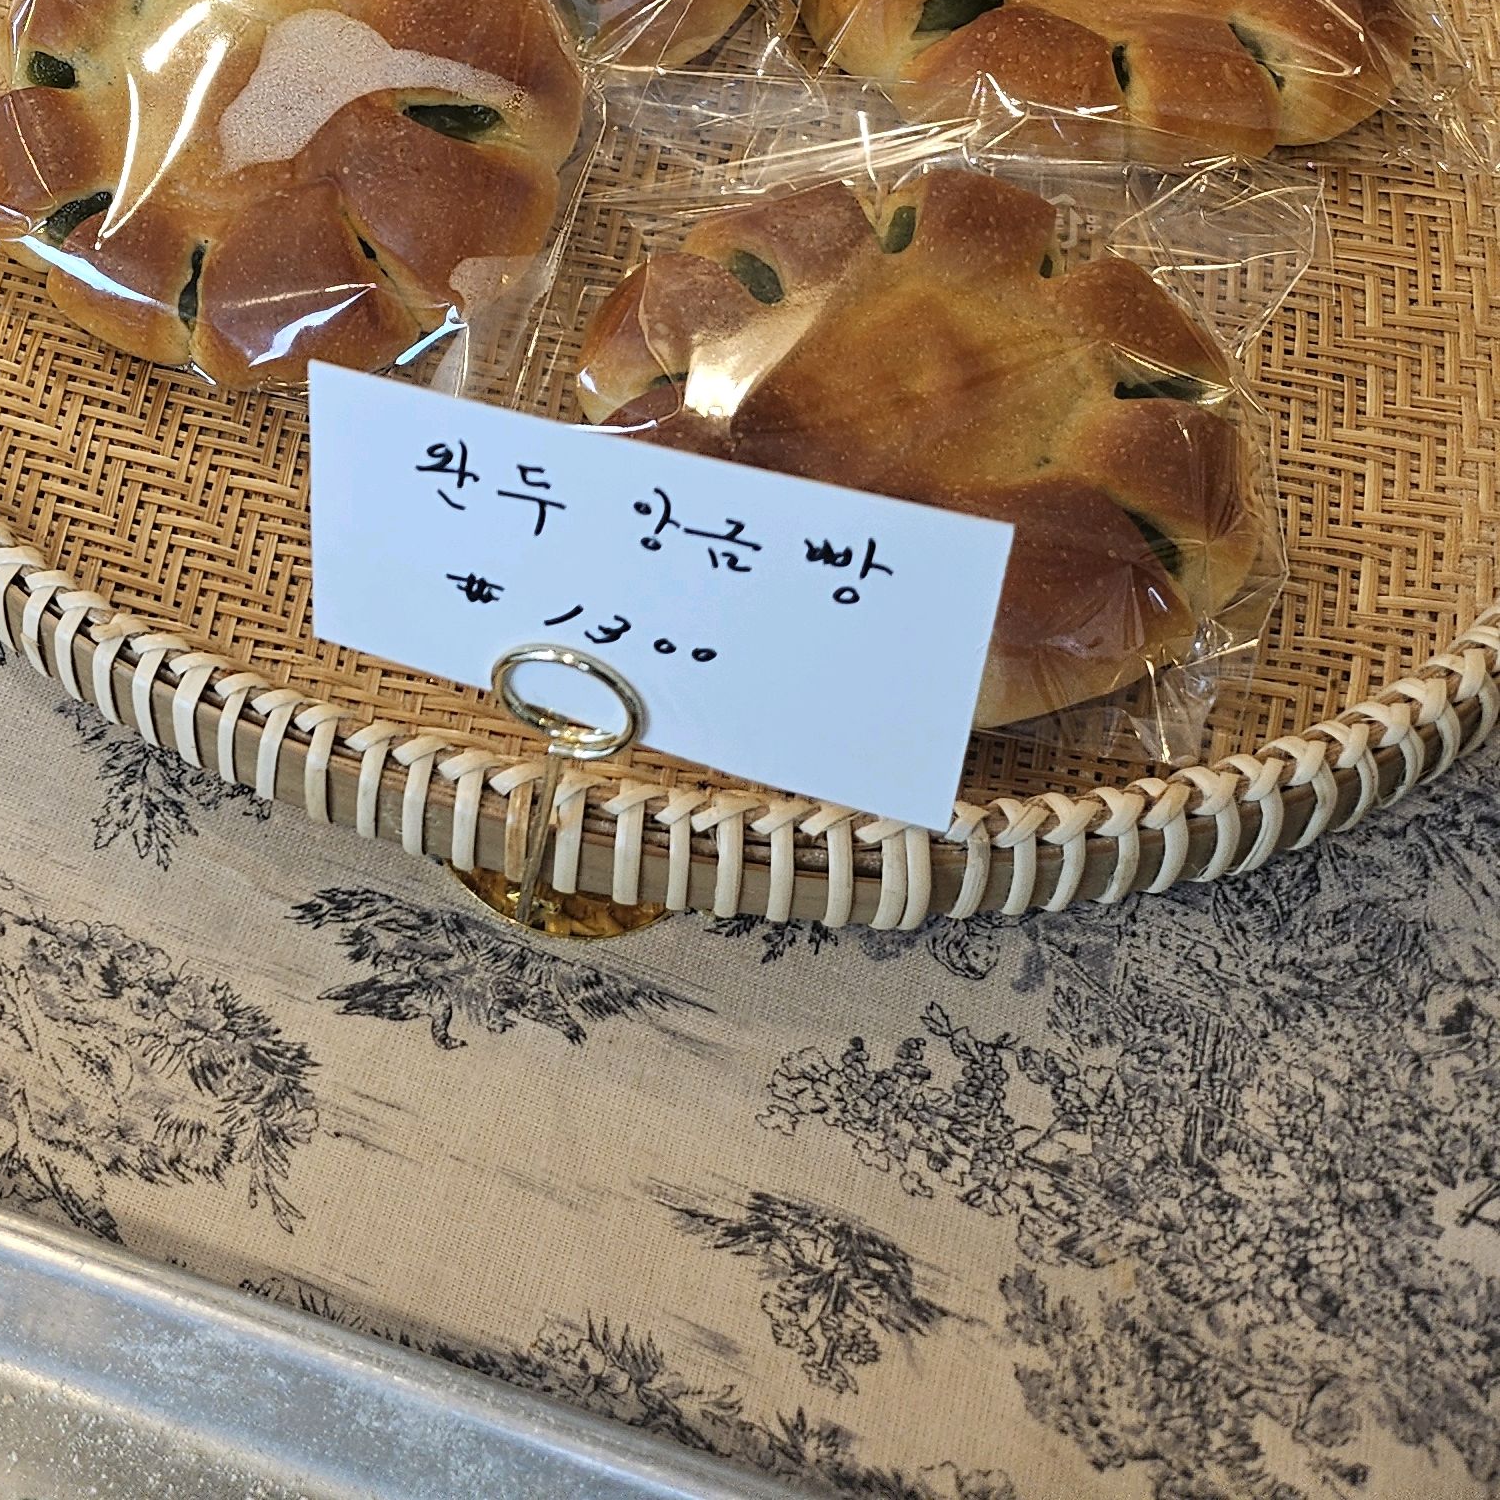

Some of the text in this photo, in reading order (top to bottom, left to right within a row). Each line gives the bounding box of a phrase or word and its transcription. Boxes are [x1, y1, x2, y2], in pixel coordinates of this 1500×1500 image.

[415, 439, 894, 605] 완두 앙금 빵
